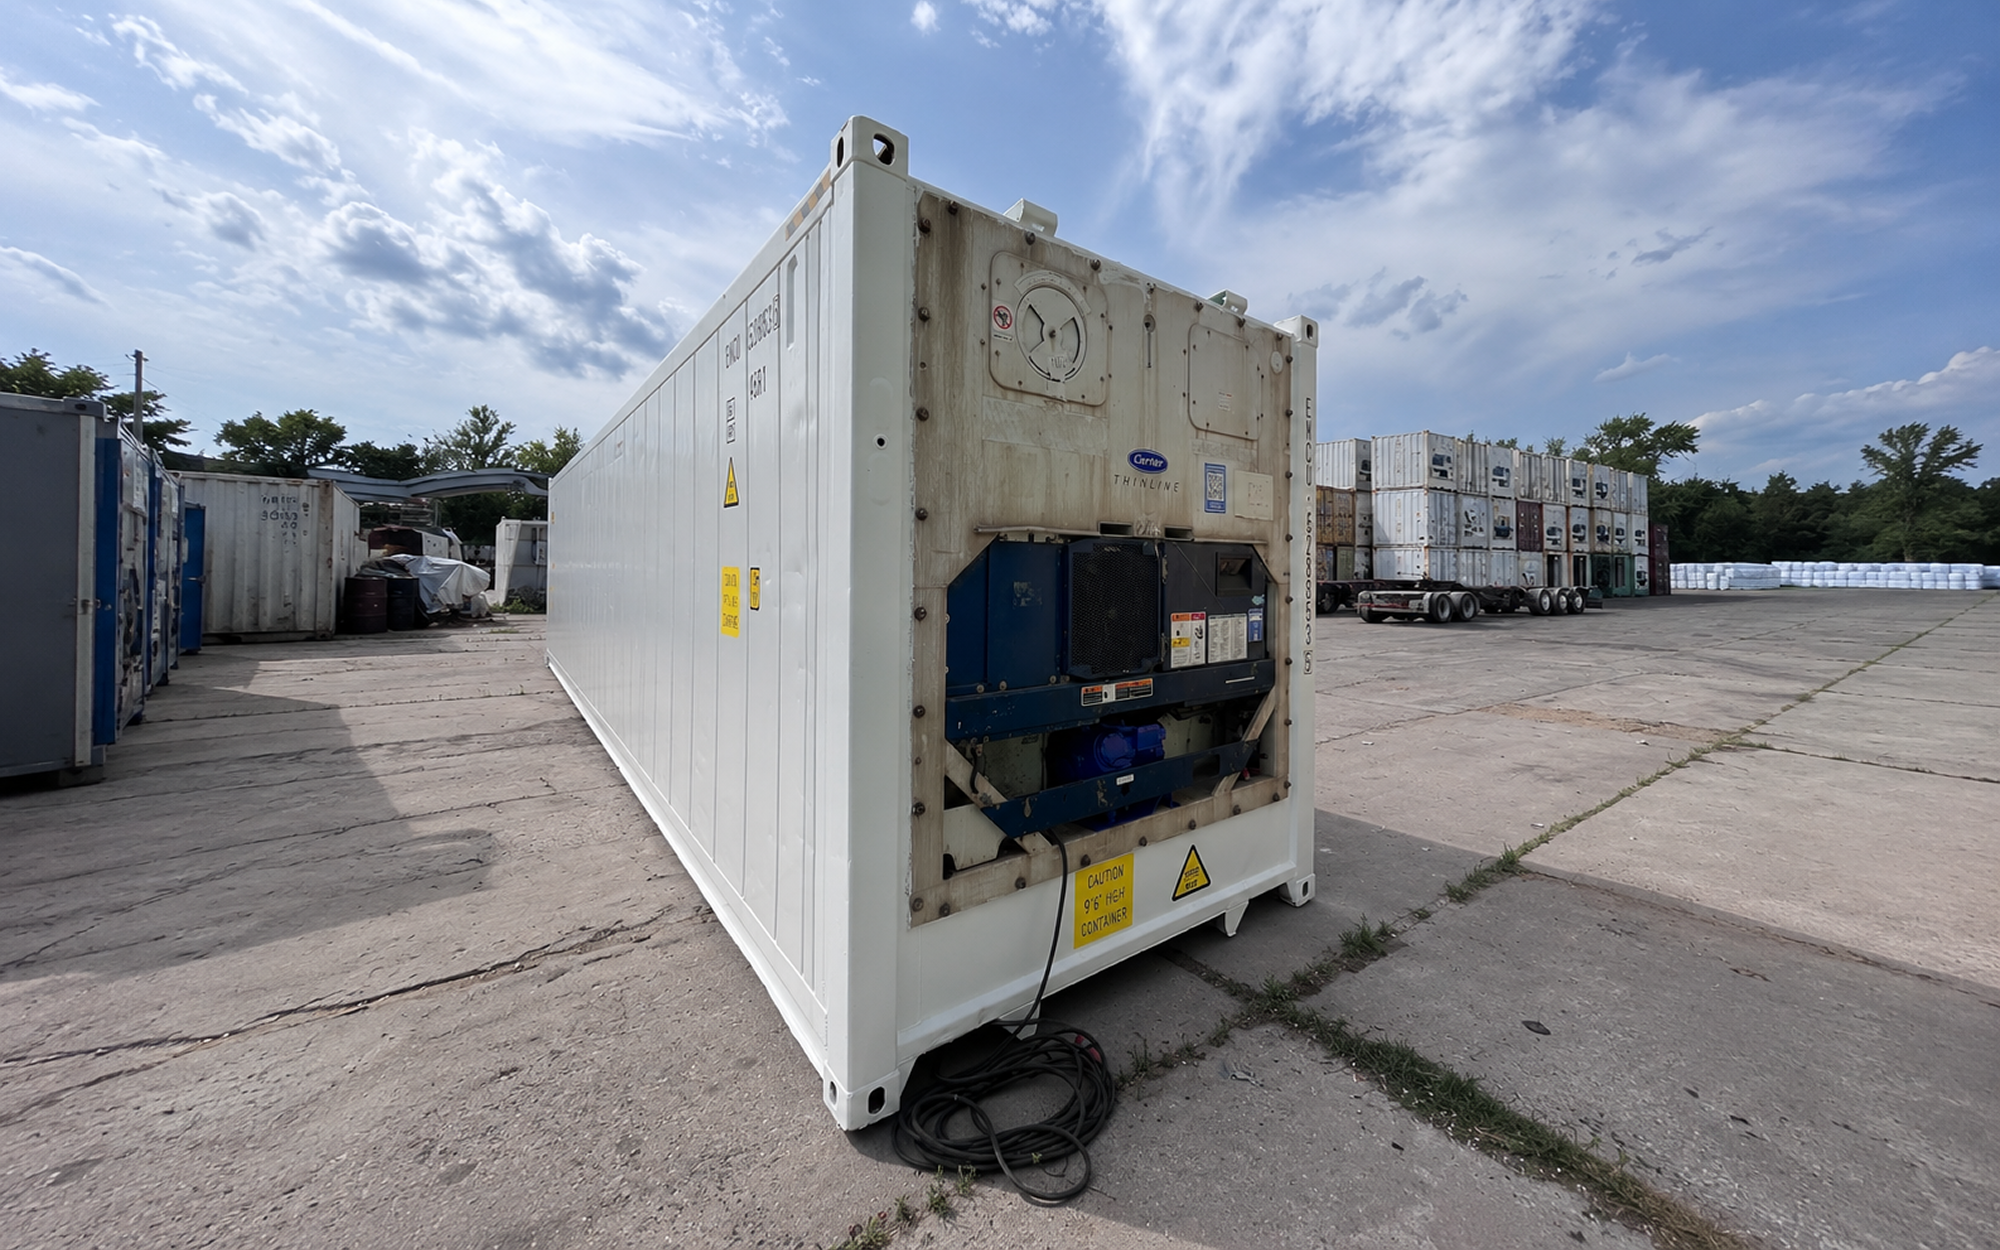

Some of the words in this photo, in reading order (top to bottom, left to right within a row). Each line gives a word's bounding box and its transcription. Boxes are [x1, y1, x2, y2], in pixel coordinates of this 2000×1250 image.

[1113, 474, 1181, 493] THINLINE
[1087, 864, 1125, 889] CAUTION
[1081, 907, 1128, 937] CONTAINER
